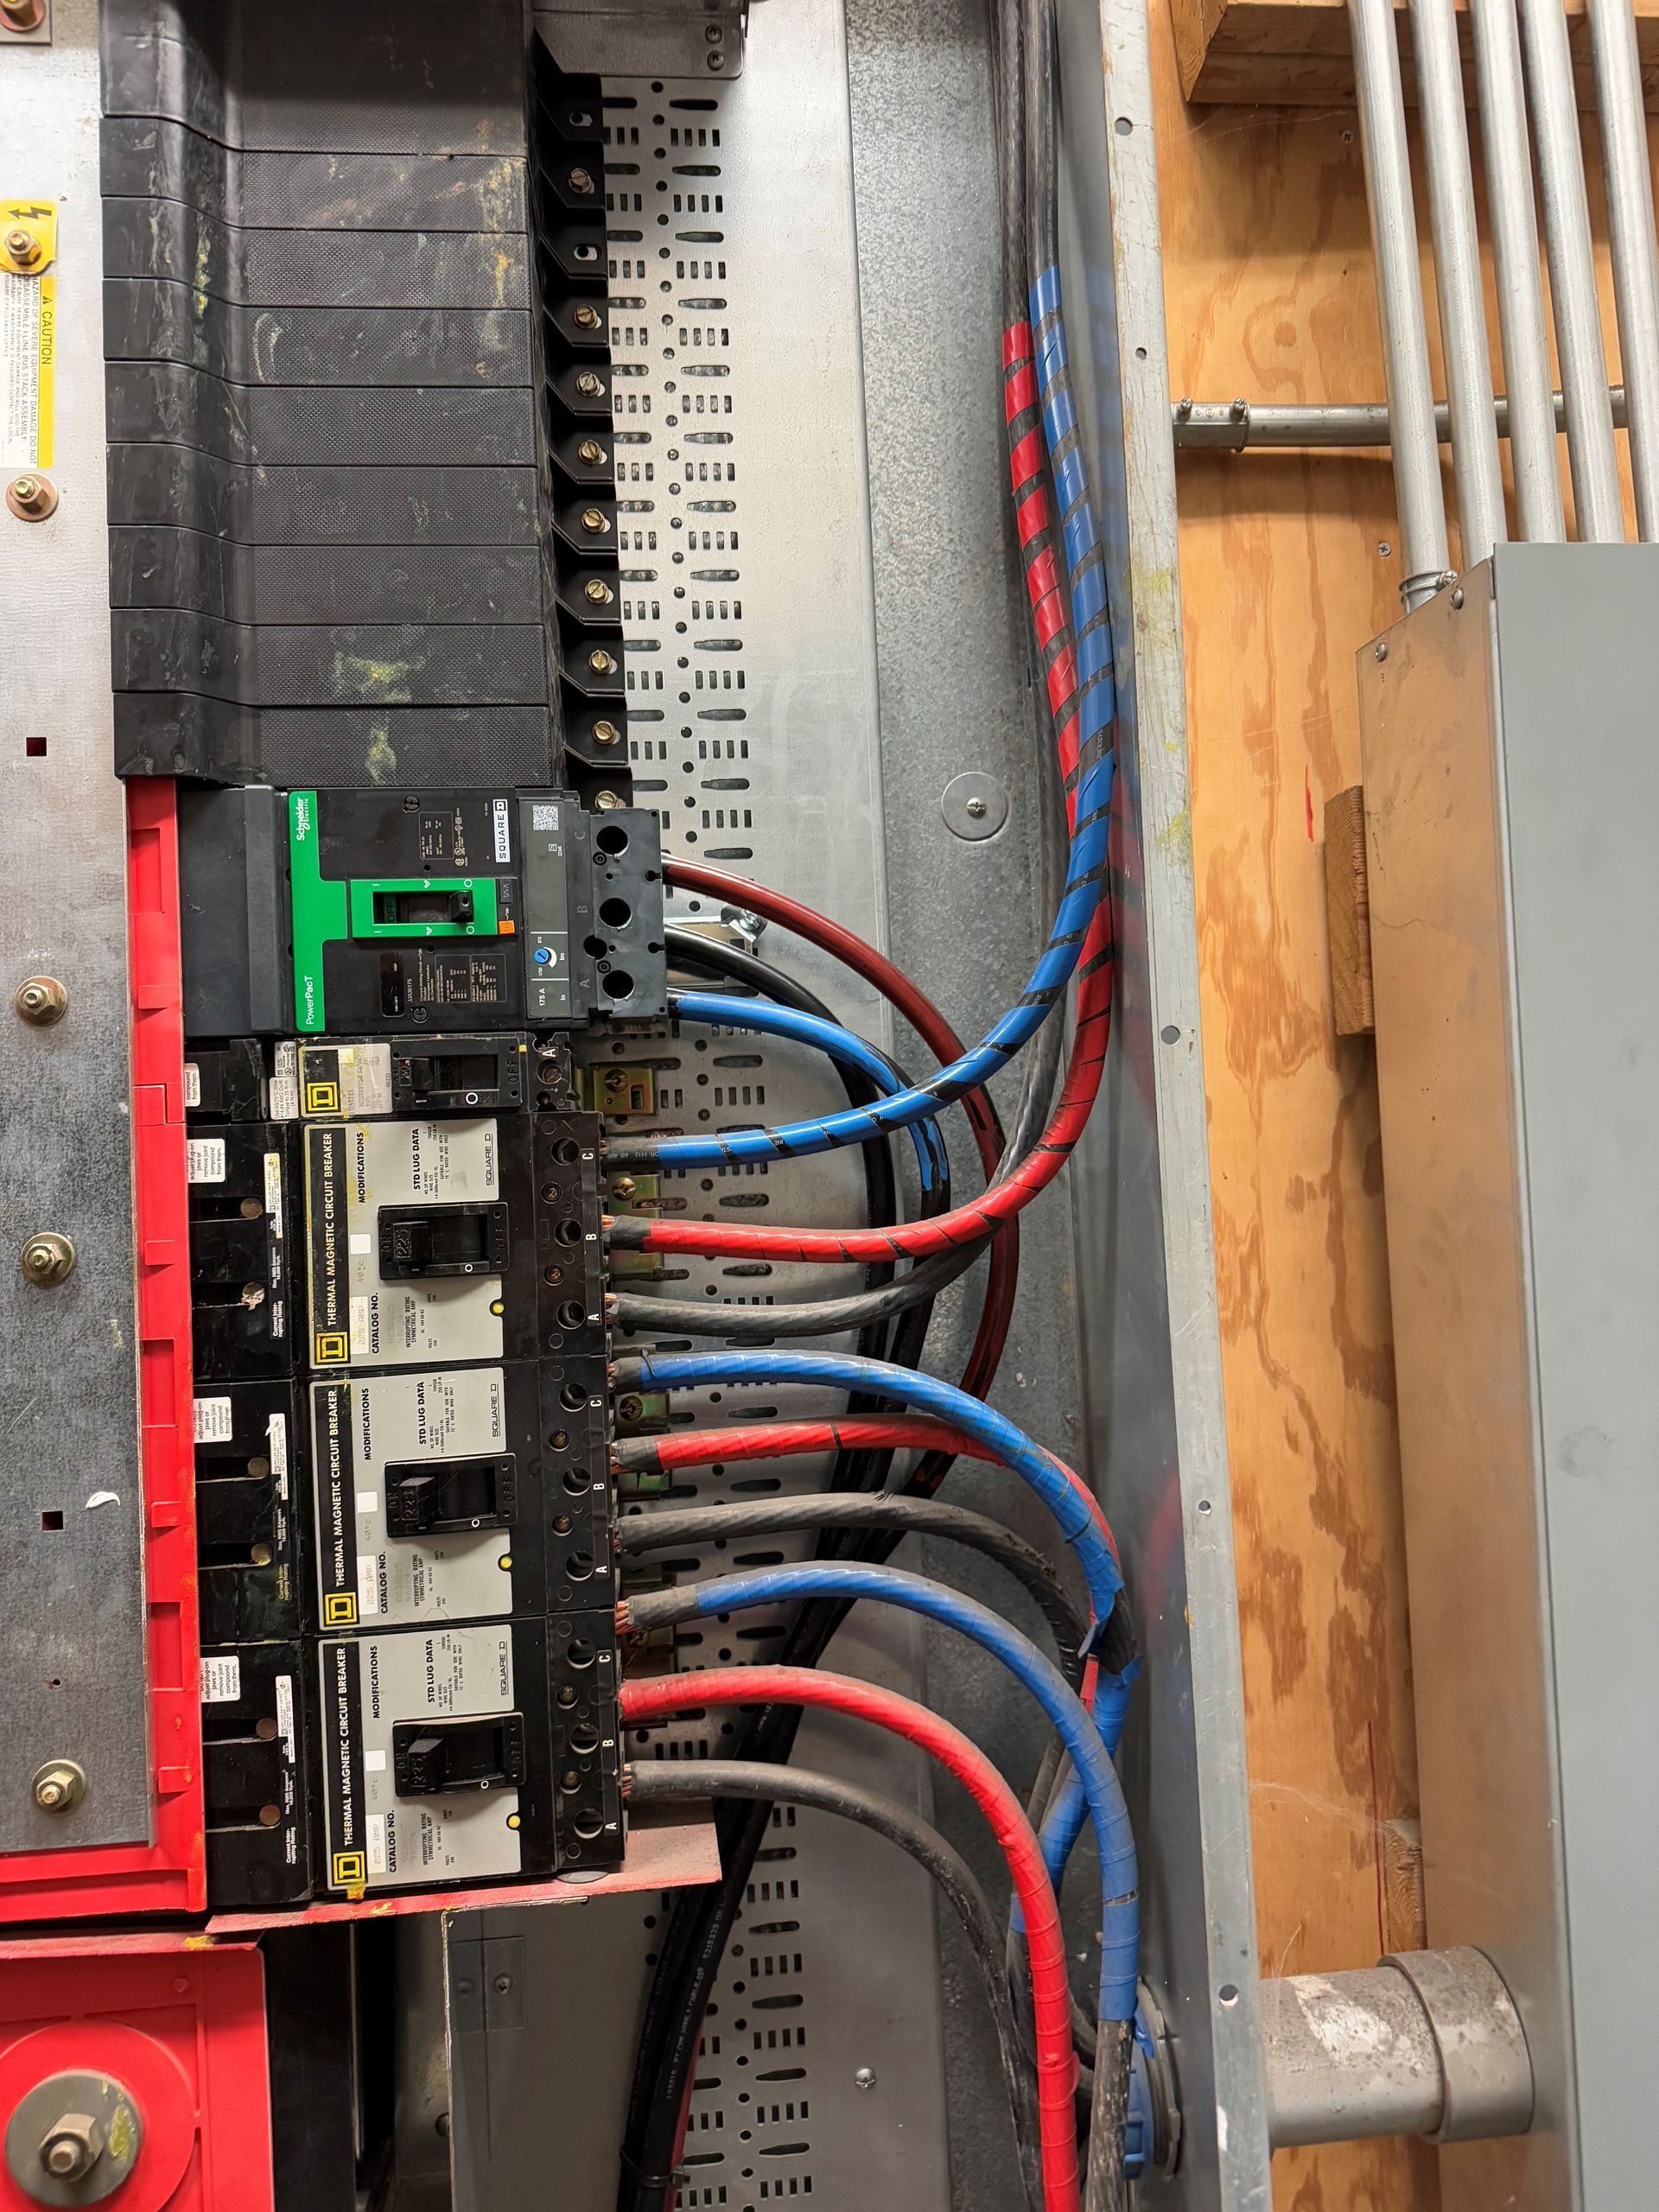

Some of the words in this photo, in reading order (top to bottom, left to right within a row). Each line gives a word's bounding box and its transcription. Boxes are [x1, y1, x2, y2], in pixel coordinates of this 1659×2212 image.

[32, 309, 38, 320] OF
[42, 311, 52, 364] CAUTION
[30, 436, 36, 447] DO
[296, 798, 306, 841] Schneider
[498, 814, 506, 859] SQUARE
[574, 831, 585, 840] C
[304, 976, 314, 1025] PowerPacT
[579, 979, 590, 988] A
[508, 1060, 519, 1083] OFF
[542, 1049, 556, 1057] A
[324, 1133, 332, 1177] BREAKER
[357, 1133, 366, 1203] MODIFICATIONS
[325, 1181, 334, 1219] CIRCUIT
[326, 1222, 336, 1273] MAGNETIC
[327, 1279, 336, 1326] THERMAL
[371, 1313, 380, 1354] CATALOG
[328, 1391, 338, 1436] BREAKER
[416, 1382, 425, 1404] DATA
[362, 1388, 371, 1460] MODIFICATIONS
[418, 1429, 427, 1445] STD
[330, 1439, 340, 1478] CIRCUIT
[332, 1481, 343, 1536] MAGNETIC
[334, 1539, 345, 1587] THERMAL
[366, 1564, 374, 1582] AMP
[379, 1573, 388, 1614] CATALOG
[337, 1648, 346, 1694] BREAKER
[370, 1646, 380, 1719] MODIFICATIONS
[427, 1687, 435, 1703] STD
[339, 1697, 349, 1736] CIRCUIT
[341, 1739, 351, 1794] MAGNETIC
[343, 1798, 353, 1846] THERMAL
[388, 1831, 396, 1873] CATALOG
